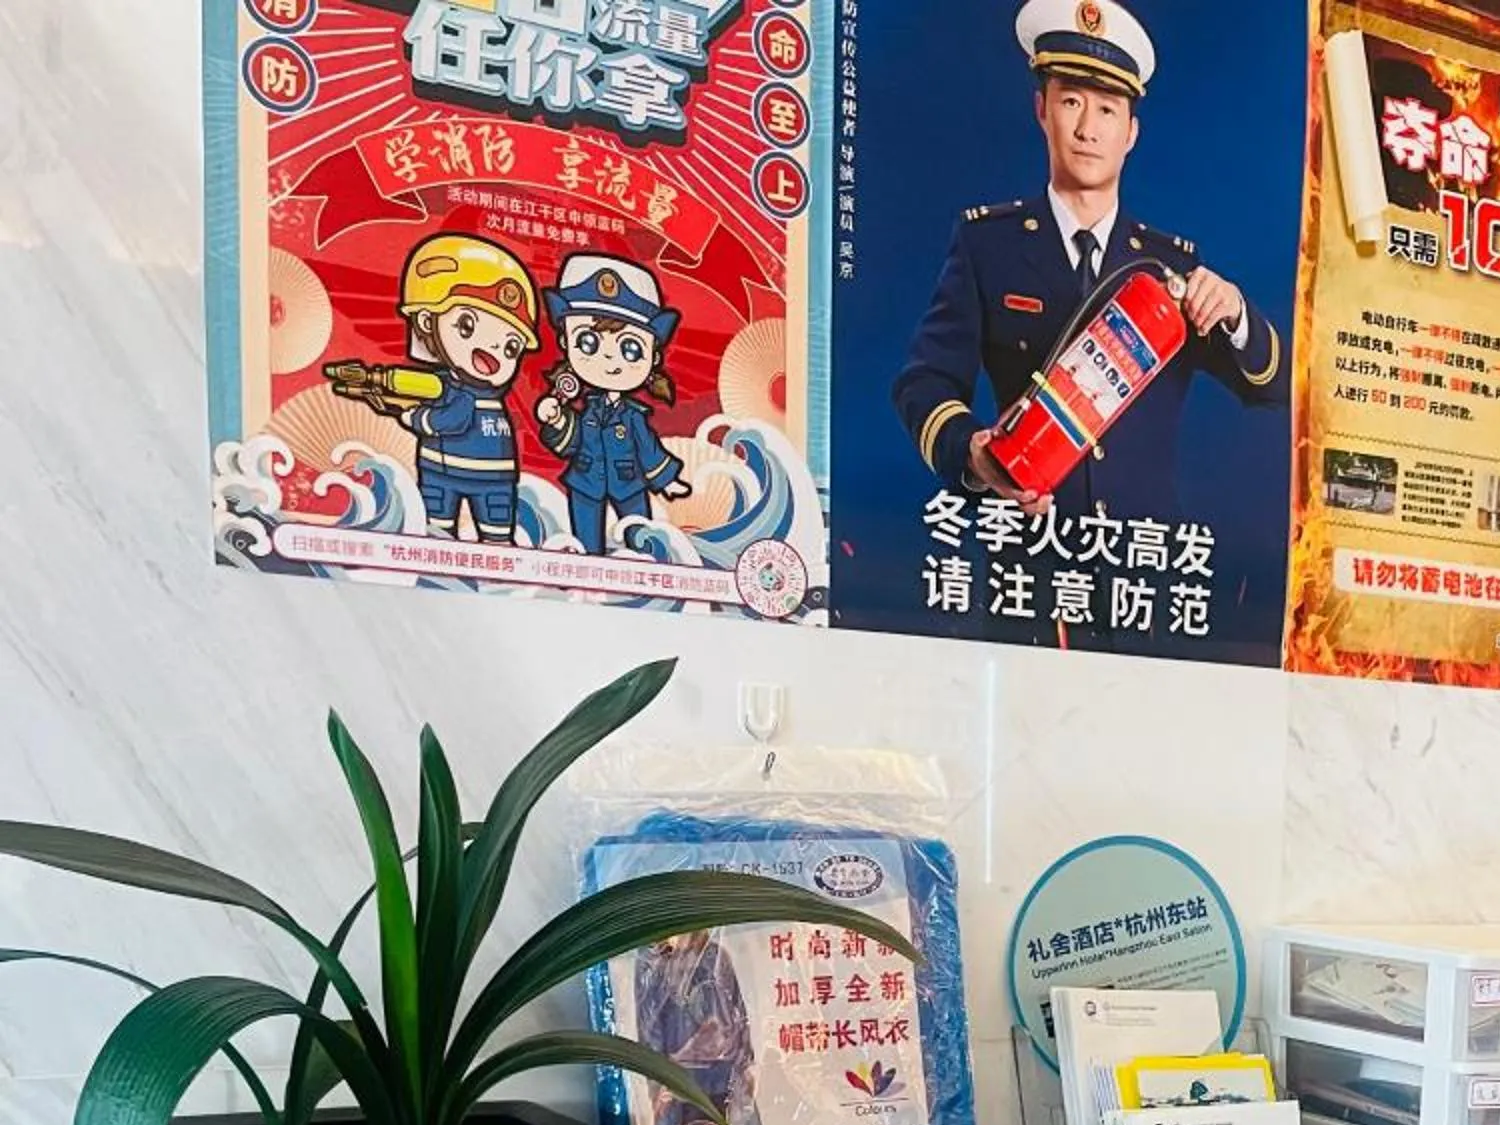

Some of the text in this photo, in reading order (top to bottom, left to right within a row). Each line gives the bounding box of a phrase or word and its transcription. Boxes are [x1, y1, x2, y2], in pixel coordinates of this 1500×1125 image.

[403, 0, 686, 126] 任你拿
[384, 124, 679, 233] 学消防 享流量
[1382, 98, 1491, 184] 夺命
[1387, 225, 1439, 266] 只需
[481, 415, 512, 438] 杭州
[922, 489, 1216, 578] 冬季火灾高发
[921, 553, 1211, 636] 请注意防范
[774, 970, 906, 1007] 加厚全新
